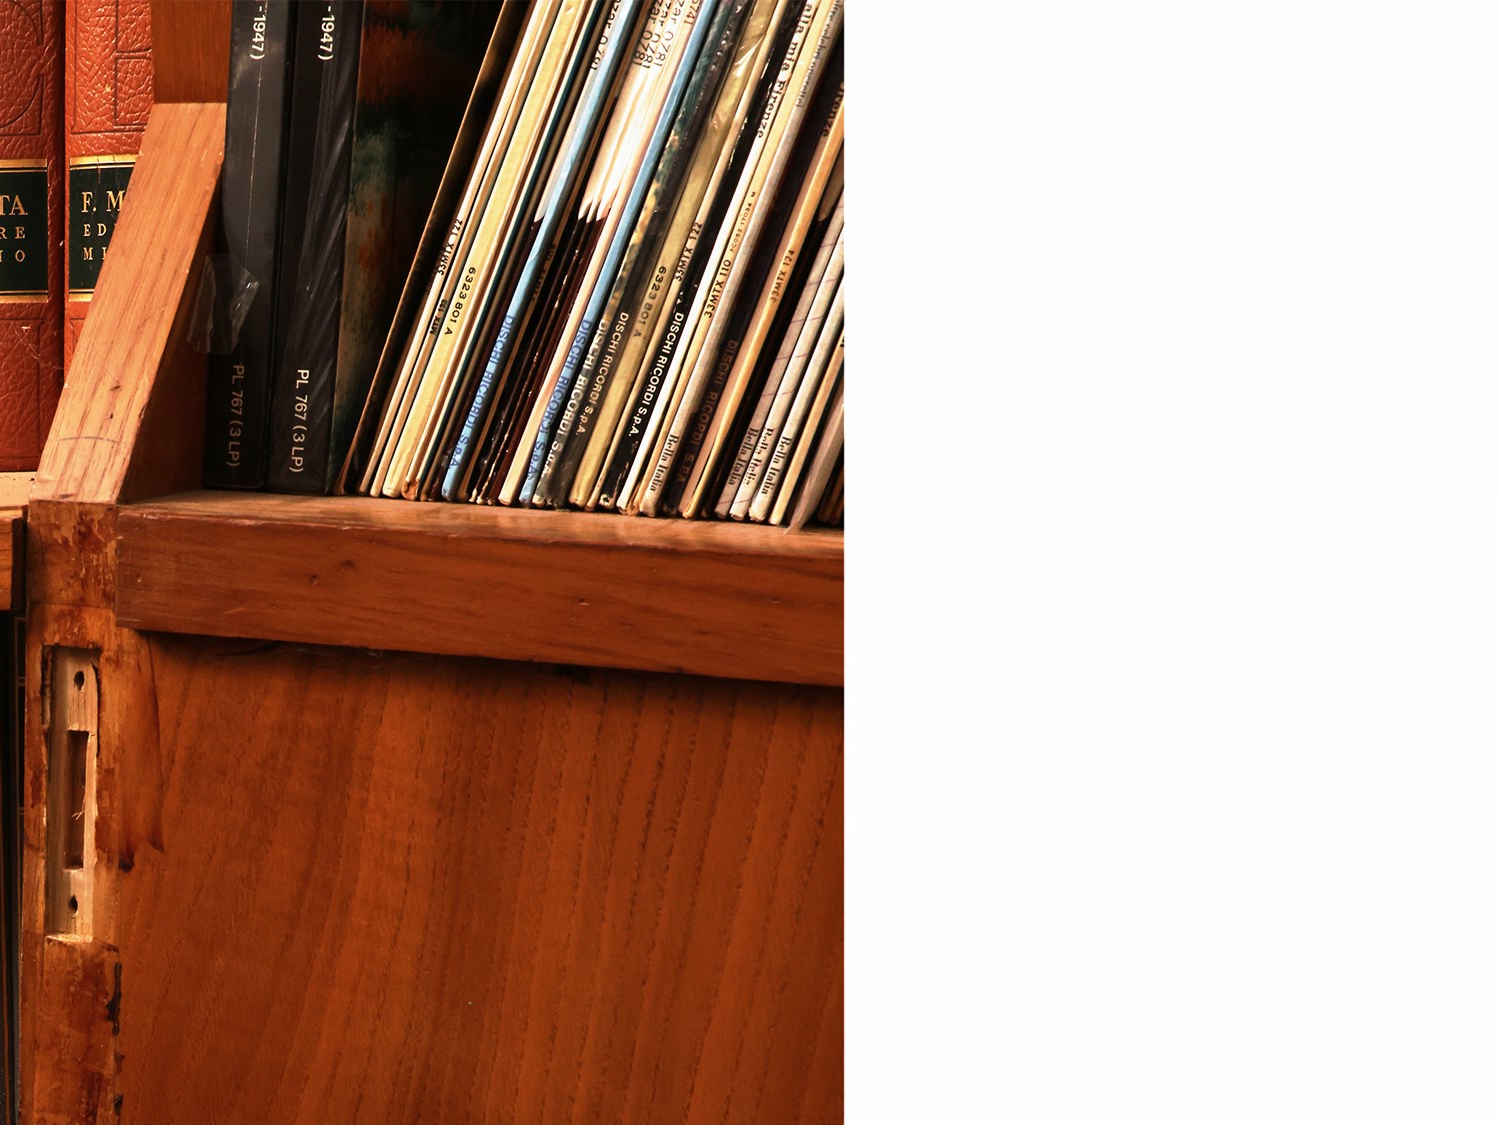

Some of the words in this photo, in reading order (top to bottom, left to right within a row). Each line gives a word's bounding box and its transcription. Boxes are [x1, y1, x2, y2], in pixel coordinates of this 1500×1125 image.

[249, 14, 266, 60] 1947)
[317, 14, 335, 61] 1947)
[632, 30, 653, 66] 0781
[654, 31, 674, 66] 0781
[781, 41, 798, 72] mia
[758, 79, 787, 138] Firenze
[81, 191, 97, 213] F.
[459, 266, 476, 300] 6323
[650, 265, 667, 301] 6323
[704, 279, 724, 318] 33MTX
[719, 259, 731, 278] 110
[769, 268, 788, 302] 33MTX
[783, 249, 795, 268] 124
[450, 303, 463, 323] 801
[640, 302, 653, 325] 801
[444, 327, 453, 336] A
[491, 315, 515, 363] DISCHI
[563, 319, 591, 373] DISCHI
[582, 318, 606, 370] DISCHI
[608, 311, 629, 354] DISCHI
[661, 312, 684, 358] DISCHI
[232, 364, 245, 384] PL
[295, 369, 310, 389] PL
[591, 353, 614, 407] RICORDI
[713, 339, 739, 386] DISCHI
[465, 368, 493, 429] RICORDI
[645, 357, 668, 406] RICORDI
[230, 390, 244, 415] 767
[294, 395, 308, 420] 767
[540, 375, 570, 439] RICORDI
[557, 375, 588, 436] RICORDI
[690, 391, 719, 445] RICORDI
[663, 434, 680, 462] Bella
[740, 427, 759, 457] Bella
[773, 436, 792, 465] Bella
[650, 461, 669, 492] Italia
[728, 457, 747, 486] Italia
[761, 464, 780, 495] Italia
